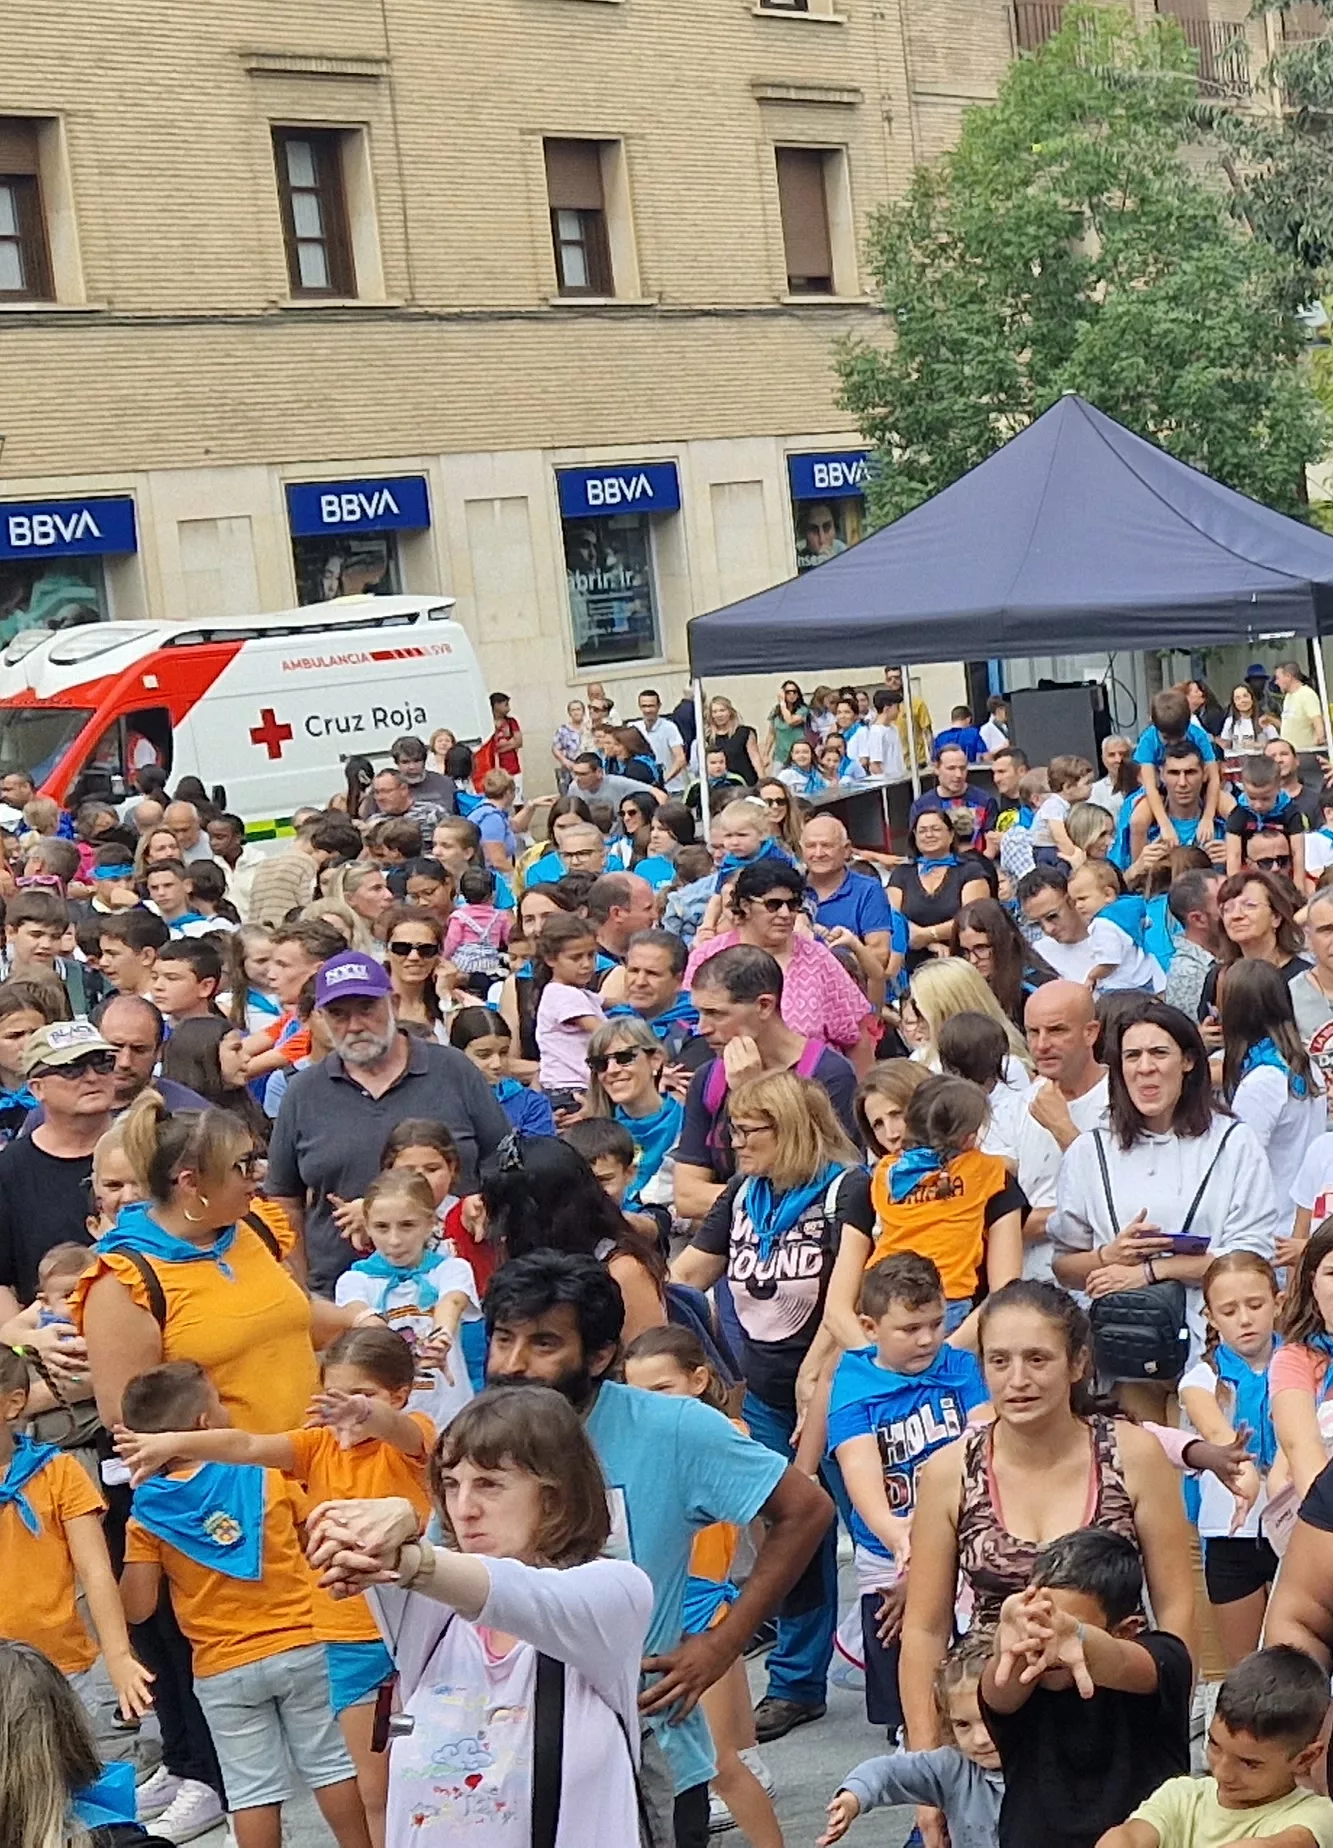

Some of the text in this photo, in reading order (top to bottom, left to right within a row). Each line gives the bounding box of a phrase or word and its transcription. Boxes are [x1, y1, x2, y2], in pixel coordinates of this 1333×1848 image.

[586, 473, 654, 506] BBVA
[813, 459, 870, 488] BBVA
[320, 487, 400, 523] BBVA
[8, 509, 102, 547] BBVA
[281, 652, 371, 671] AMBULANCIA
[304, 701, 428, 737] Cruz Roja
